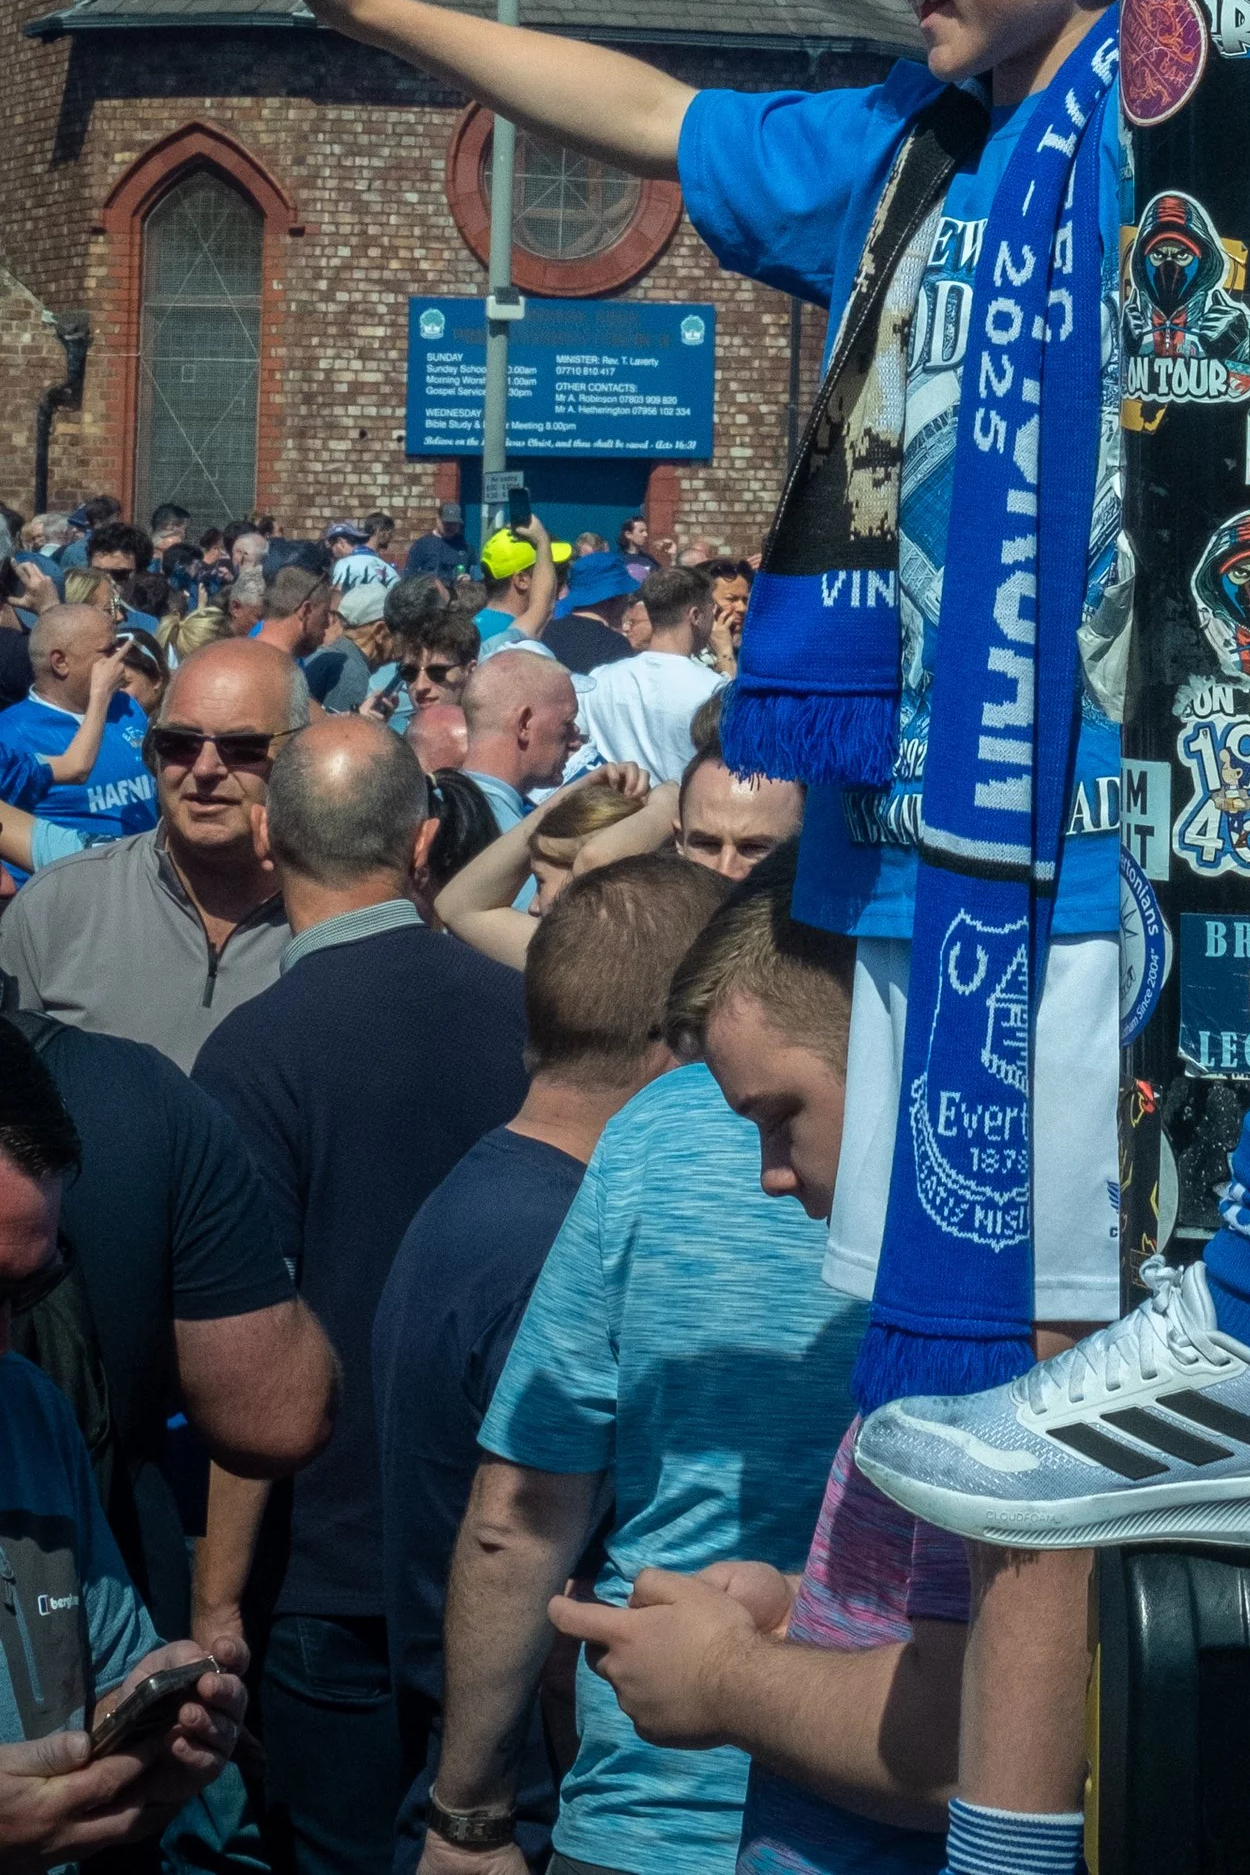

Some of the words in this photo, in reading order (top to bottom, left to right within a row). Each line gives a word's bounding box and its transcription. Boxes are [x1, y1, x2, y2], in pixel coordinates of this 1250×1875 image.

[972, 239, 1036, 454] 2025
[426, 353, 463, 361] SUNDAY
[556, 355, 600, 364] MINISTER:
[602, 356, 619, 365] Rev.
[426, 365, 457, 375] Sunday
[460, 365, 487, 374] Schoo
[556, 367, 581, 376] 07710
[426, 376, 460, 385] Morning
[1127, 357, 1149, 394] ON
[1154, 358, 1227, 397] TOUR
[426, 387, 456, 396] Gospel
[556, 382, 586, 391] OTHER
[588, 383, 638, 393] CONTACTS:
[555, 394, 566, 402] Mr
[579, 394, 617, 404] Robinson
[425, 408, 482, 417] WEDNESDAY
[555, 405, 566, 413] Mr
[425, 420, 447, 429] Bible
[449, 420, 472, 430] Study
[511, 422, 544, 432] Meeting
[821, 569, 898, 608] VIN
[87, 774, 156, 814] HAFNI
[1136, 987, 1153, 1021] Since
[938, 1091, 1028, 1141] Evert
